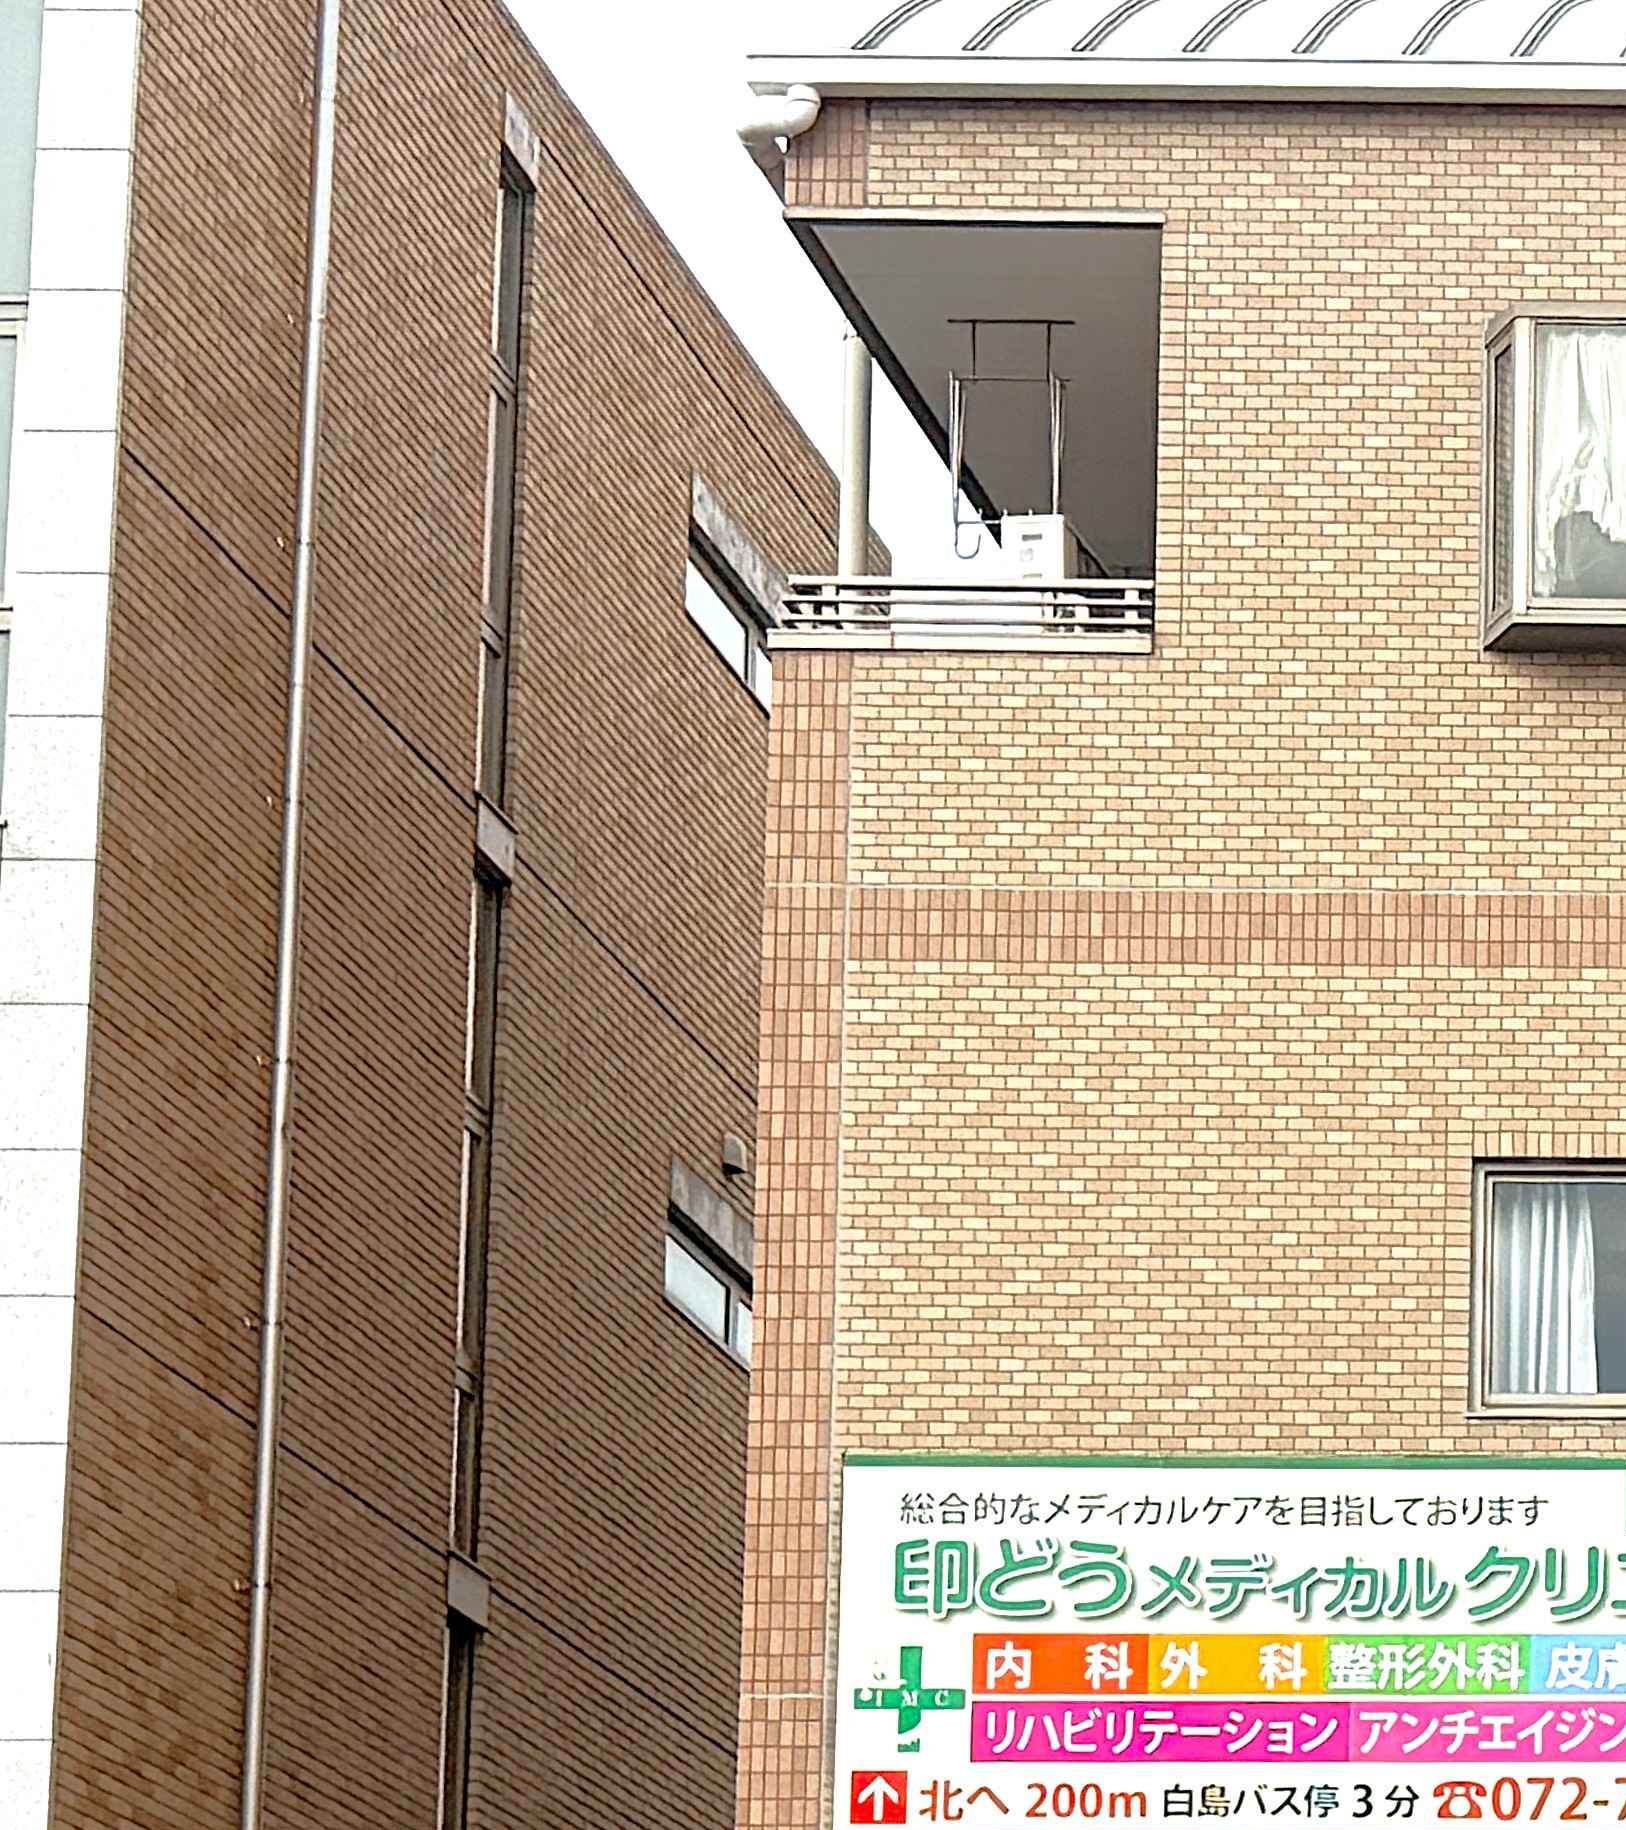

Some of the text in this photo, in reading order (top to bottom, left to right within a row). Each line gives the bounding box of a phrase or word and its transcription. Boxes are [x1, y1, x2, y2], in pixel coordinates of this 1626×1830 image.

[899, 1493, 1549, 1529] 総合的なメディカルケアを目指しております
[985, 1642, 1133, 1690] 内科
[1158, 1642, 1307, 1690] 外科
[1326, 1642, 1526, 1690] 整形外科
[983, 1709, 1339, 1755] リハビリテーション
[1024, 1781, 1148, 1821] 200m
